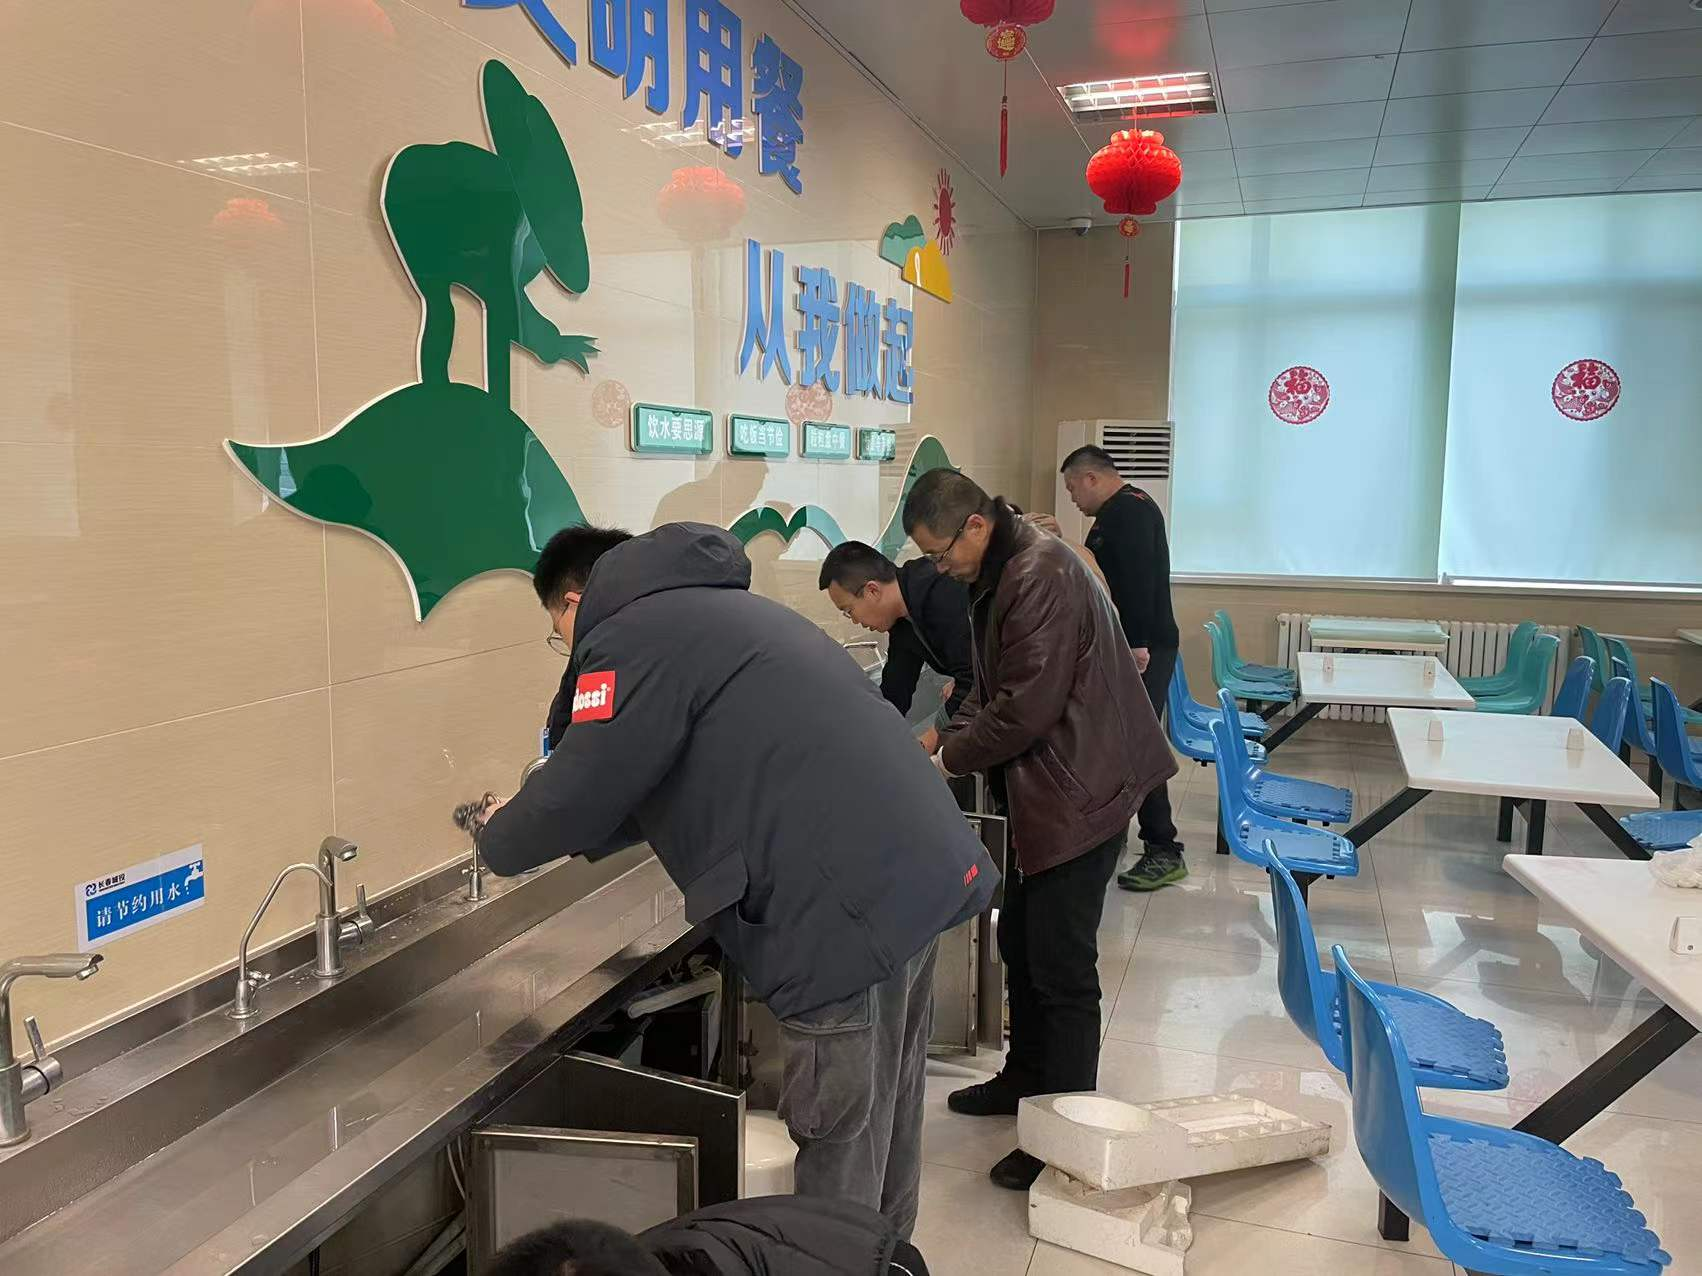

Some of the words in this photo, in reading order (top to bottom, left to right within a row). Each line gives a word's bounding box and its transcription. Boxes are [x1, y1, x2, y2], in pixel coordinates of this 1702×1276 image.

[738, 238, 914, 404] 从我做起
[647, 414, 704, 441] 饮水要思源
[97, 882, 181, 928] 请节约用水
